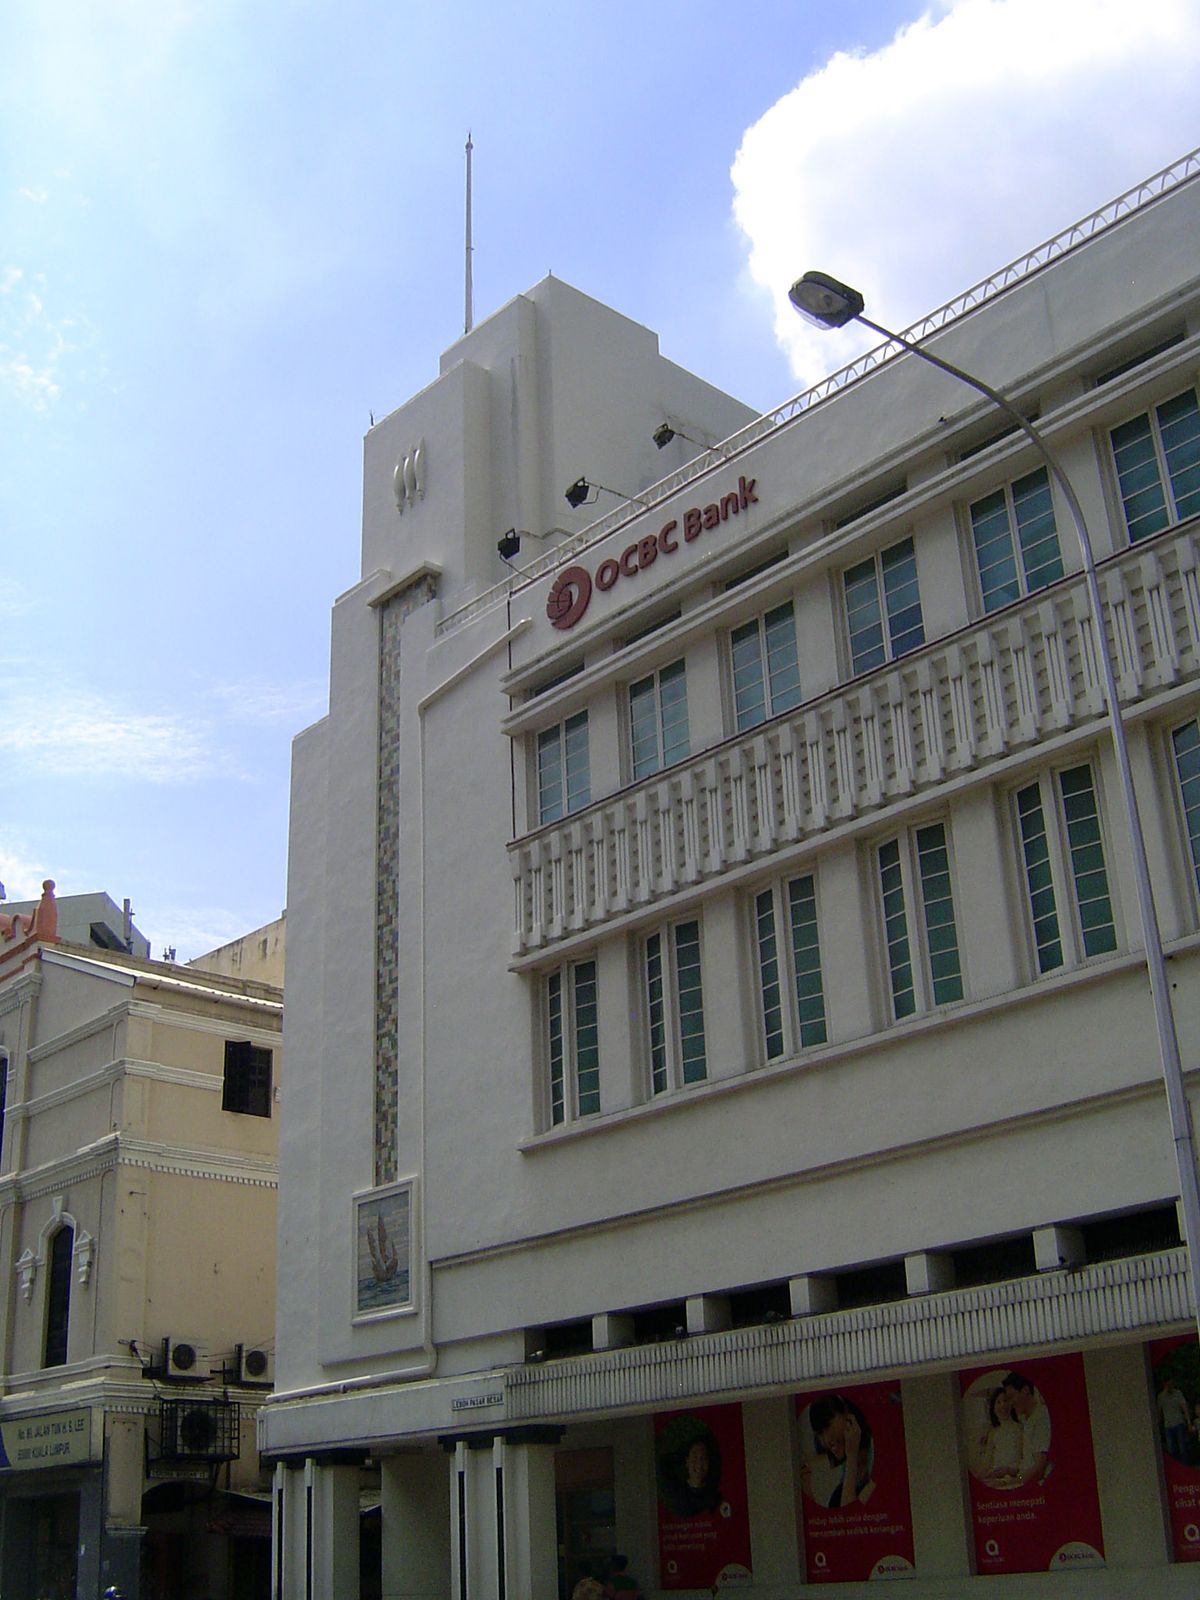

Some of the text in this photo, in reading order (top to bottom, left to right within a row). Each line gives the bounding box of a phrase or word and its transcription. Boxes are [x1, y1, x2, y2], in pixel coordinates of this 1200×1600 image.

[595, 475, 759, 592] OCBC Bank
[74, 1418, 85, 1432] LEE
[976, 1496, 1046, 1511] Sentiasa menepati
[977, 1512, 1015, 1527] keperluan
